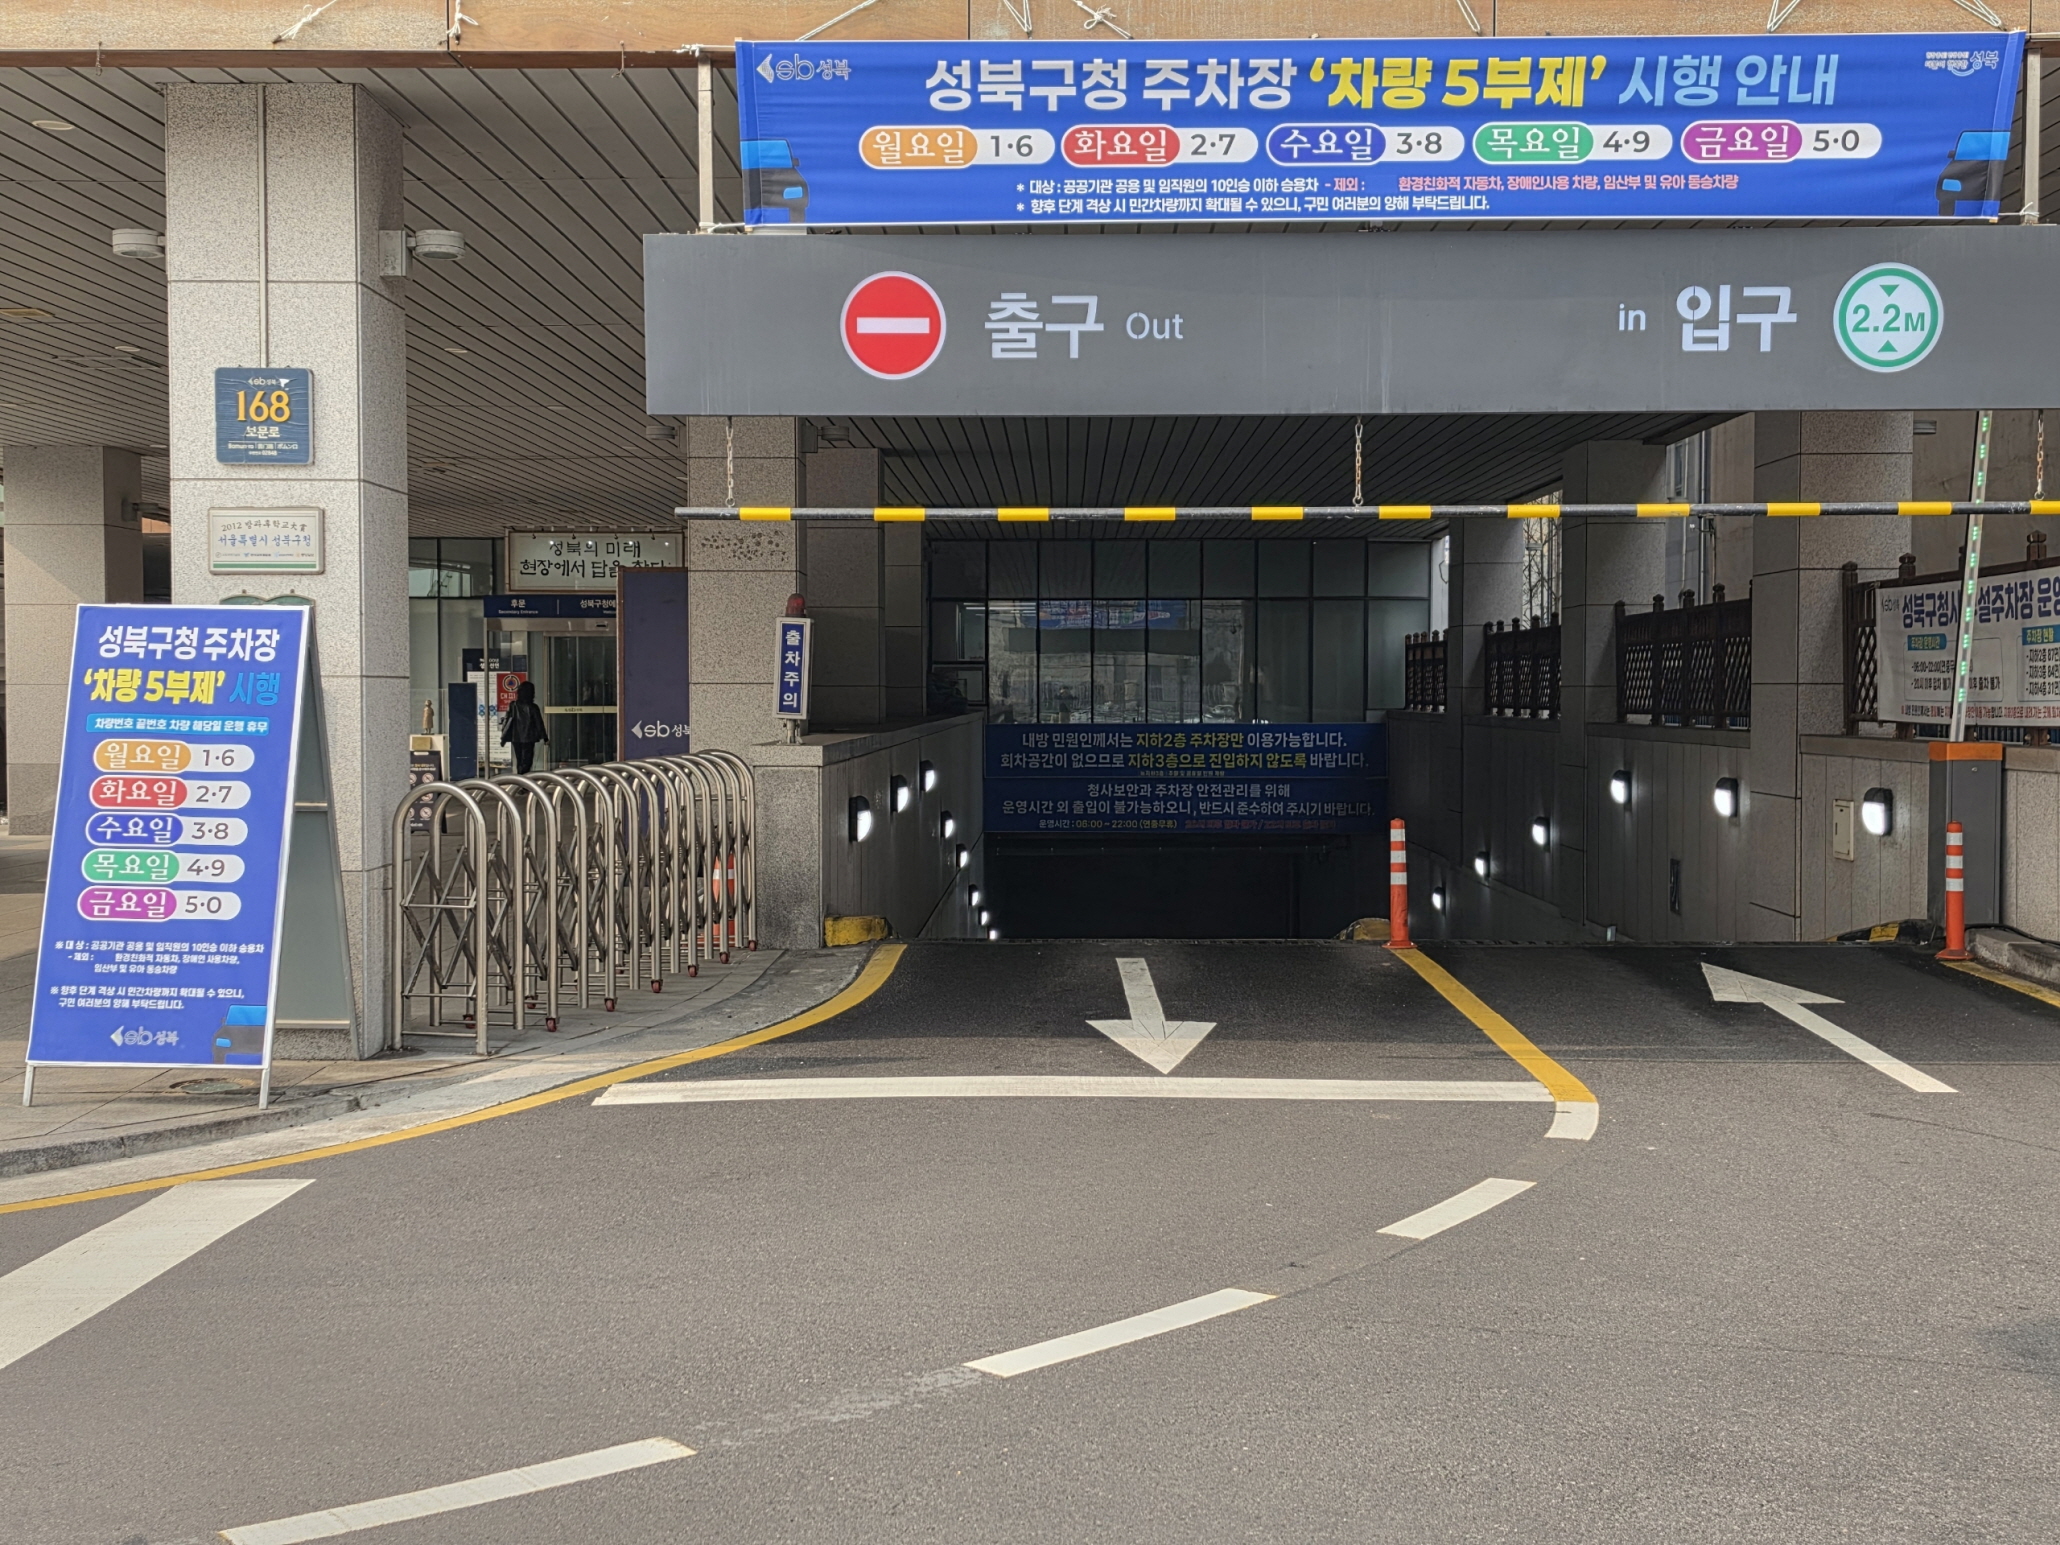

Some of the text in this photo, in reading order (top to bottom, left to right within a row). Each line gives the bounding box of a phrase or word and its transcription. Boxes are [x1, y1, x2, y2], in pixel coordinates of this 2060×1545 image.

[816, 58, 852, 81] 성북
[1969, 50, 2000, 70] 성북
[925, 53, 1839, 112] 성북구청 주차장 ‘차량 5부제’ 시행 안내
[871, 125, 1860, 165] 월요일 1·6 화요일 2·7 수요일 3·8 목요일 4·9 금요일 5·0
[1029, 178, 1319, 194] 대상 공공기관 공용 및 임직원의 10인승 이하 승용차
[1333, 174, 1739, 192] 제외 환경친화적 자동차, 장애인사용 차량, 임산부 및 유아 동승차량
[1031, 194, 1490, 214] 향후 단계 격상 시 민간차량까지 확대될 수 있으니, 구민 여러분의 양해 부탁드립니다.
[984, 292, 1184, 360] 출구 Out
[1618, 283, 1798, 353] in 입구
[1851, 302, 1926, 334] 2.2M
[236, 389, 291, 423] 168
[245, 426, 281, 440] 보문로
[221, 520, 243, 532] 2012
[218, 533, 311, 548] 서울특별시 성북구청
[549, 541, 641, 558] 성북의 미래
[520, 559, 585, 578] 현장에서
[510, 598, 526, 608] 후문
[1974, 579, 2035, 624] 설주차장
[98, 625, 281, 662] 성북구청 주차장
[782, 629, 801, 709] 출차주의
[83, 668, 281, 706] ‘차량 5부제’ 시행
[94, 717, 268, 733] 차량번호 끝번호 차량 해당일 운행 휴무
[643, 719, 671, 738] sb
[1022, 731, 1348, 748] 내방 민원인께서는 지하2층 주차장만 이용가능합니다.
[104, 742, 236, 770] 월요일 1·6
[1000, 752, 1369, 769] 회차공간이 없으므로 지하3층으로 진입하지 않도록 바랍니다.
[99, 779, 232, 808] 화요일 2·7
[1087, 783, 1290, 798] 청사보안과 주차장 안전관리를 위해
[1002, 800, 1376, 817] 운영시간 외 출입이 불가능하오니, 반드시 준수하여 주시기 바랍니다.
[96, 816, 229, 844] 수요일 3·8
[1039, 819, 1071, 829] 운영시간
[1076, 819, 1103, 829] 06:00
[1112, 819, 1138, 828] 22:00
[92, 853, 225, 881] 목요일 4·9
[89, 890, 222, 919] 금요일 5·0
[91, 941, 265, 954] 공공기관 공용 임직원의 10인승 이하 승용차
[73, 952, 240, 965] 제외 환경친화적 자동차, 장애인 사용차량,
[94, 963, 178, 975] 임산부 유아 동승차량
[61, 986, 245, 999] 향후 단계 격상 민간차량까지 확대될 있으니,
[58, 998, 184, 1010] 구민 여러분의 양해 부탁드립니다.
[153, 1031, 179, 1046] 성북
